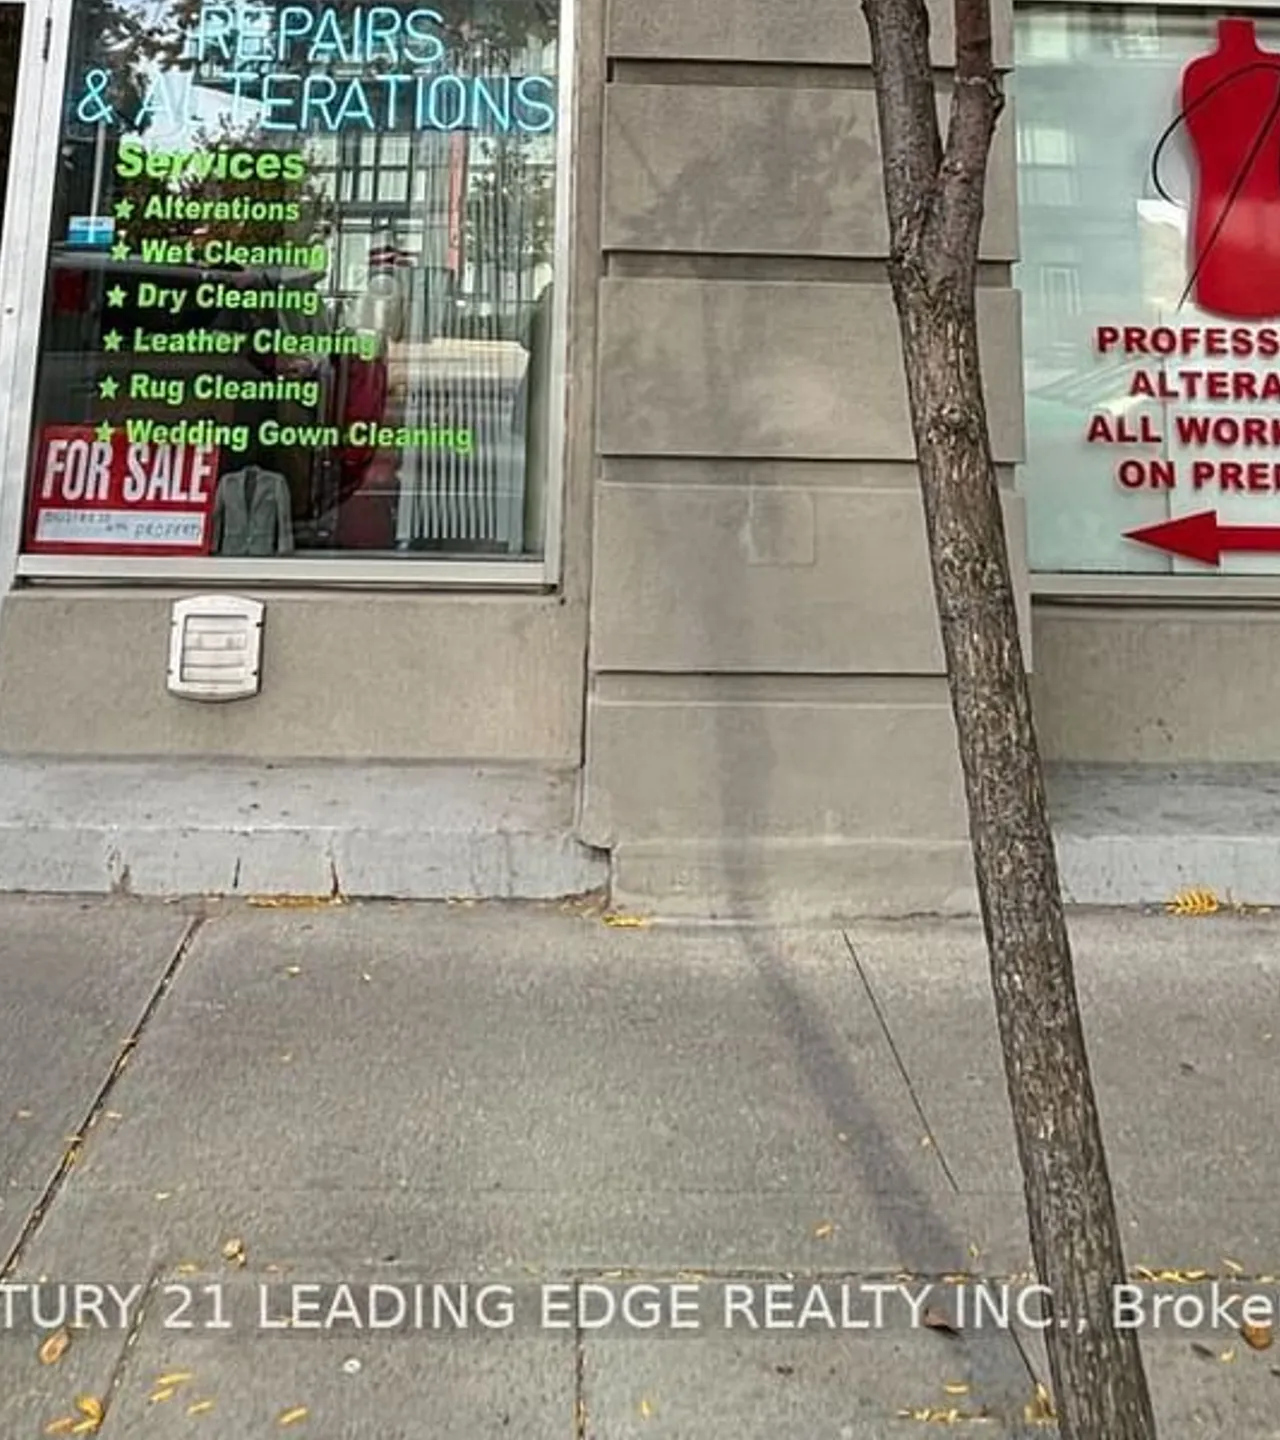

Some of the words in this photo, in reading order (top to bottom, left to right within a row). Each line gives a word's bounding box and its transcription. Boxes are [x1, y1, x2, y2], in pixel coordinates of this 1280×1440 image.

[197, 6, 444, 63] REPAIRS
[77, 68, 113, 125] &
[134, 73, 555, 133] ALTERATIONS
[116, 142, 306, 180] Services
[143, 196, 300, 222] Alterations
[141, 239, 198, 265] Wet
[204, 240, 328, 271] Cleaning
[137, 283, 187, 315] Dry
[196, 285, 320, 316] Cleaning
[133, 327, 246, 353] Leather
[253, 329, 377, 360] Cleaning
[130, 374, 185, 406] Rug
[193, 375, 319, 406] Cleaning
[126, 420, 250, 452] Wedding
[258, 421, 339, 448] Gown
[349, 422, 475, 452] Cleaning
[1087, 415, 1162, 444] ALL
[41, 439, 114, 501] FOR
[122, 436, 214, 503] SALE
[1119, 460, 1176, 489] ON
